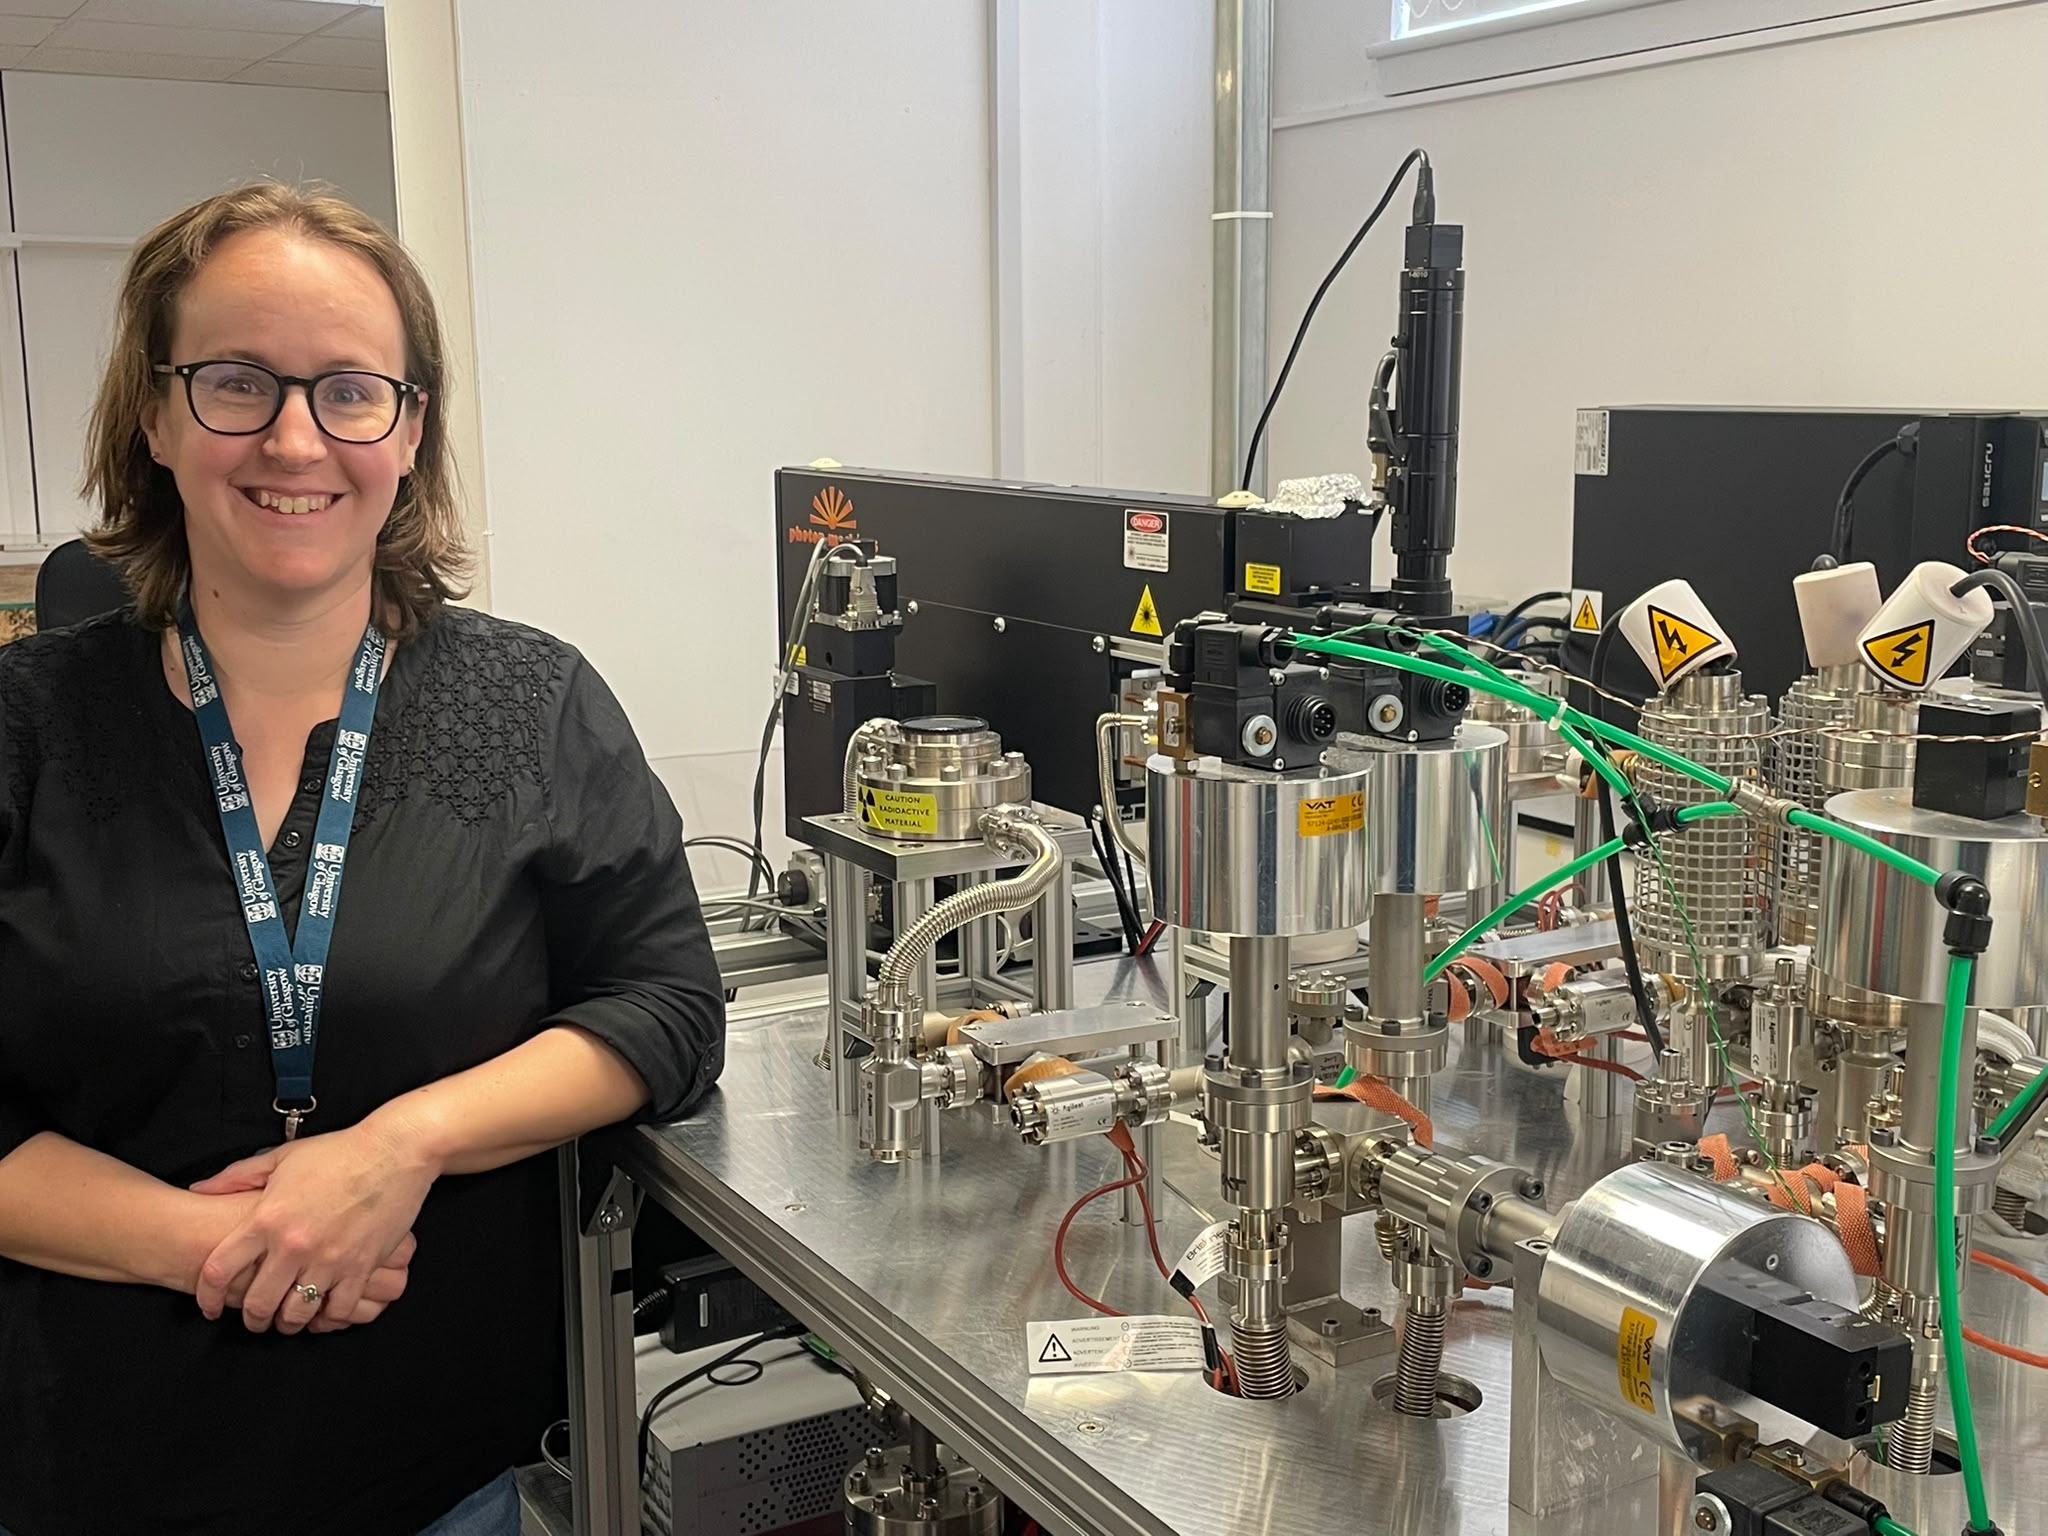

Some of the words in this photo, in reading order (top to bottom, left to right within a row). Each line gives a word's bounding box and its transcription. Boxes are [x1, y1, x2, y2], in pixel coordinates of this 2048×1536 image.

[1132, 517, 1160, 529] DANGER
[354, 650, 372, 692] Glasgow
[363, 647, 384, 695] University
[209, 746, 230, 796] University
[221, 742, 240, 784] Glasgow
[330, 757, 350, 801] Glasgow
[340, 750, 364, 804] University
[879, 805, 930, 816] RADIOACTIVE
[885, 794, 921, 804] CAUTION
[1306, 800, 1336, 810] VAT
[885, 818, 922, 828] MATERIAL
[234, 852, 257, 905] University
[247, 849, 266, 893] Glasgow
[317, 863, 342, 919] University
[306, 871, 328, 917] Glasgow
[265, 969, 284, 1030] University
[278, 967, 295, 1018] Glasgow
[1062, 1102, 1085, 1112] Agilent
[1642, 1335, 1654, 1366] VAT
